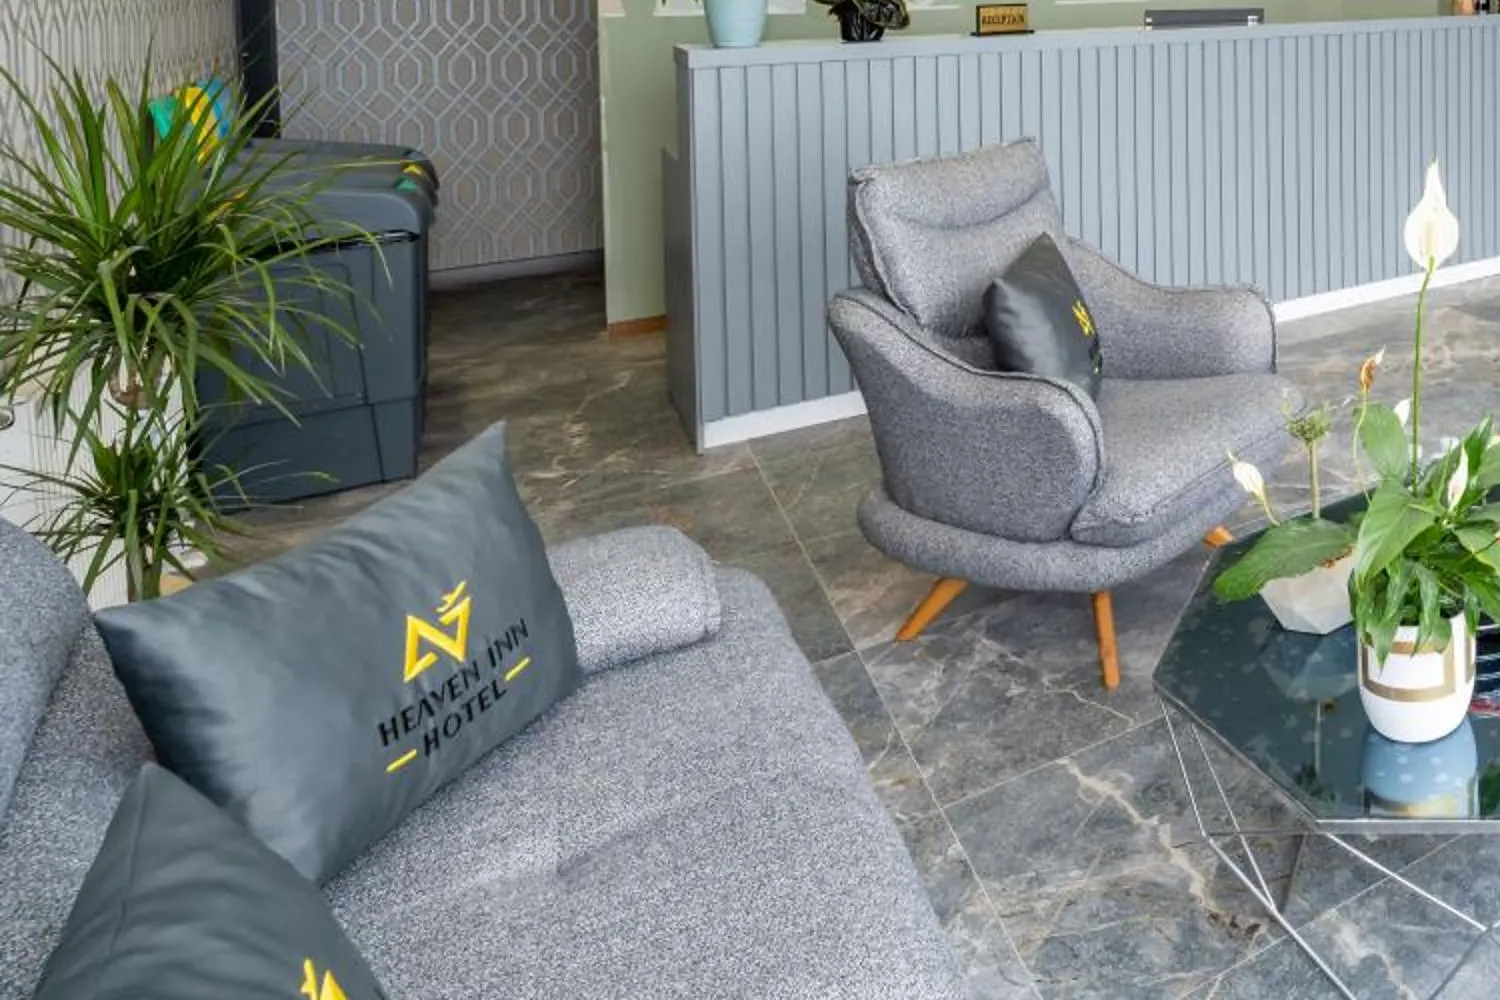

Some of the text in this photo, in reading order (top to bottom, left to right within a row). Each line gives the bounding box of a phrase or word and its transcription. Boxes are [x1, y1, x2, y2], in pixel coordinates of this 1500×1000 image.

[379, 617, 529, 746] HEAVEN INN
[422, 679, 508, 757] HOTEL
